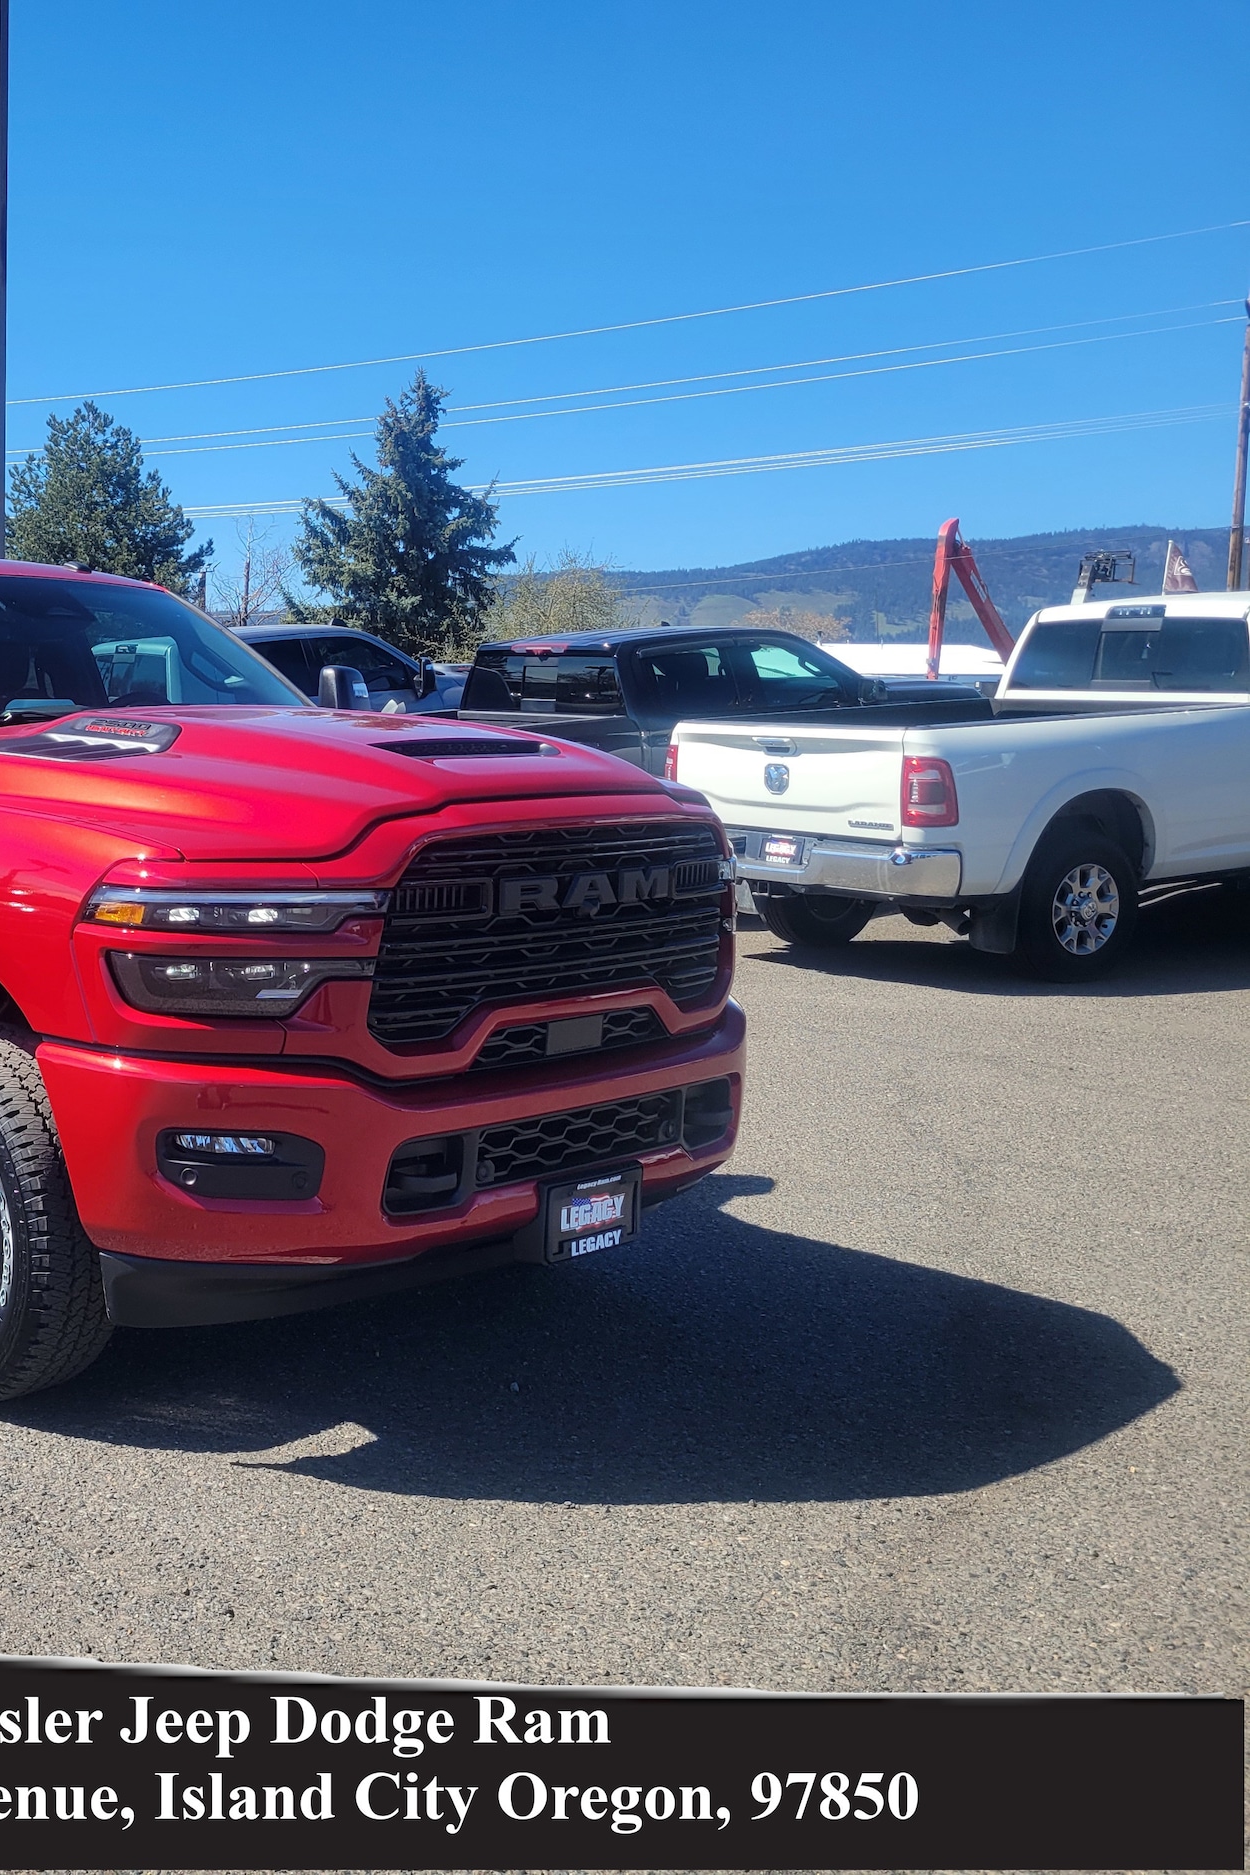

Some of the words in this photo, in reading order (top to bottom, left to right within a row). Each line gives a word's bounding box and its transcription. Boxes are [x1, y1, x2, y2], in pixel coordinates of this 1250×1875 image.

[90, 719, 152, 730] 2500
[500, 865, 670, 915] RAM
[561, 1194, 625, 1230] LEGACY
[571, 1229, 622, 1257] LEGACY
